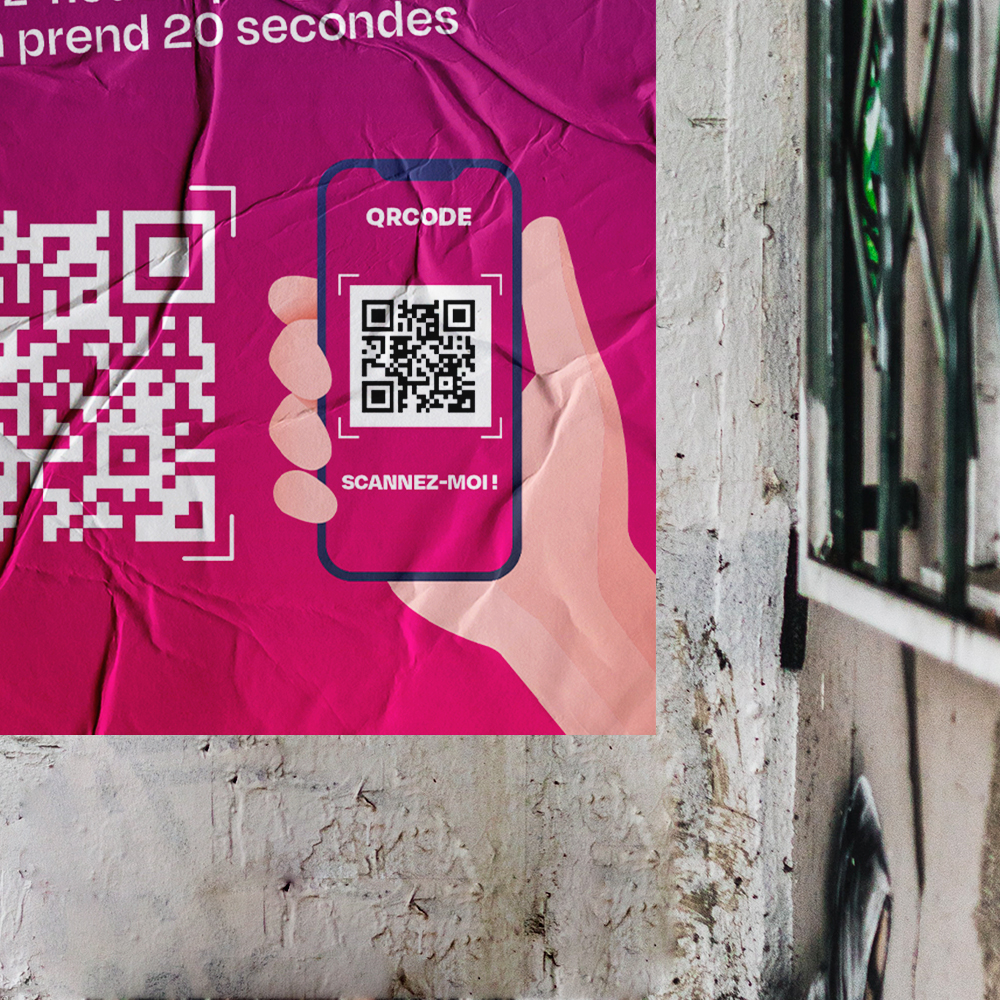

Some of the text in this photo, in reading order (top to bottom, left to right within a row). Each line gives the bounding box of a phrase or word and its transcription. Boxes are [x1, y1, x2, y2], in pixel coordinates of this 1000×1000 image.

[18, 13, 150, 65] prend
[164, 12, 224, 49] 20
[237, 0, 459, 46] secondes
[366, 207, 472, 227] QRCODE
